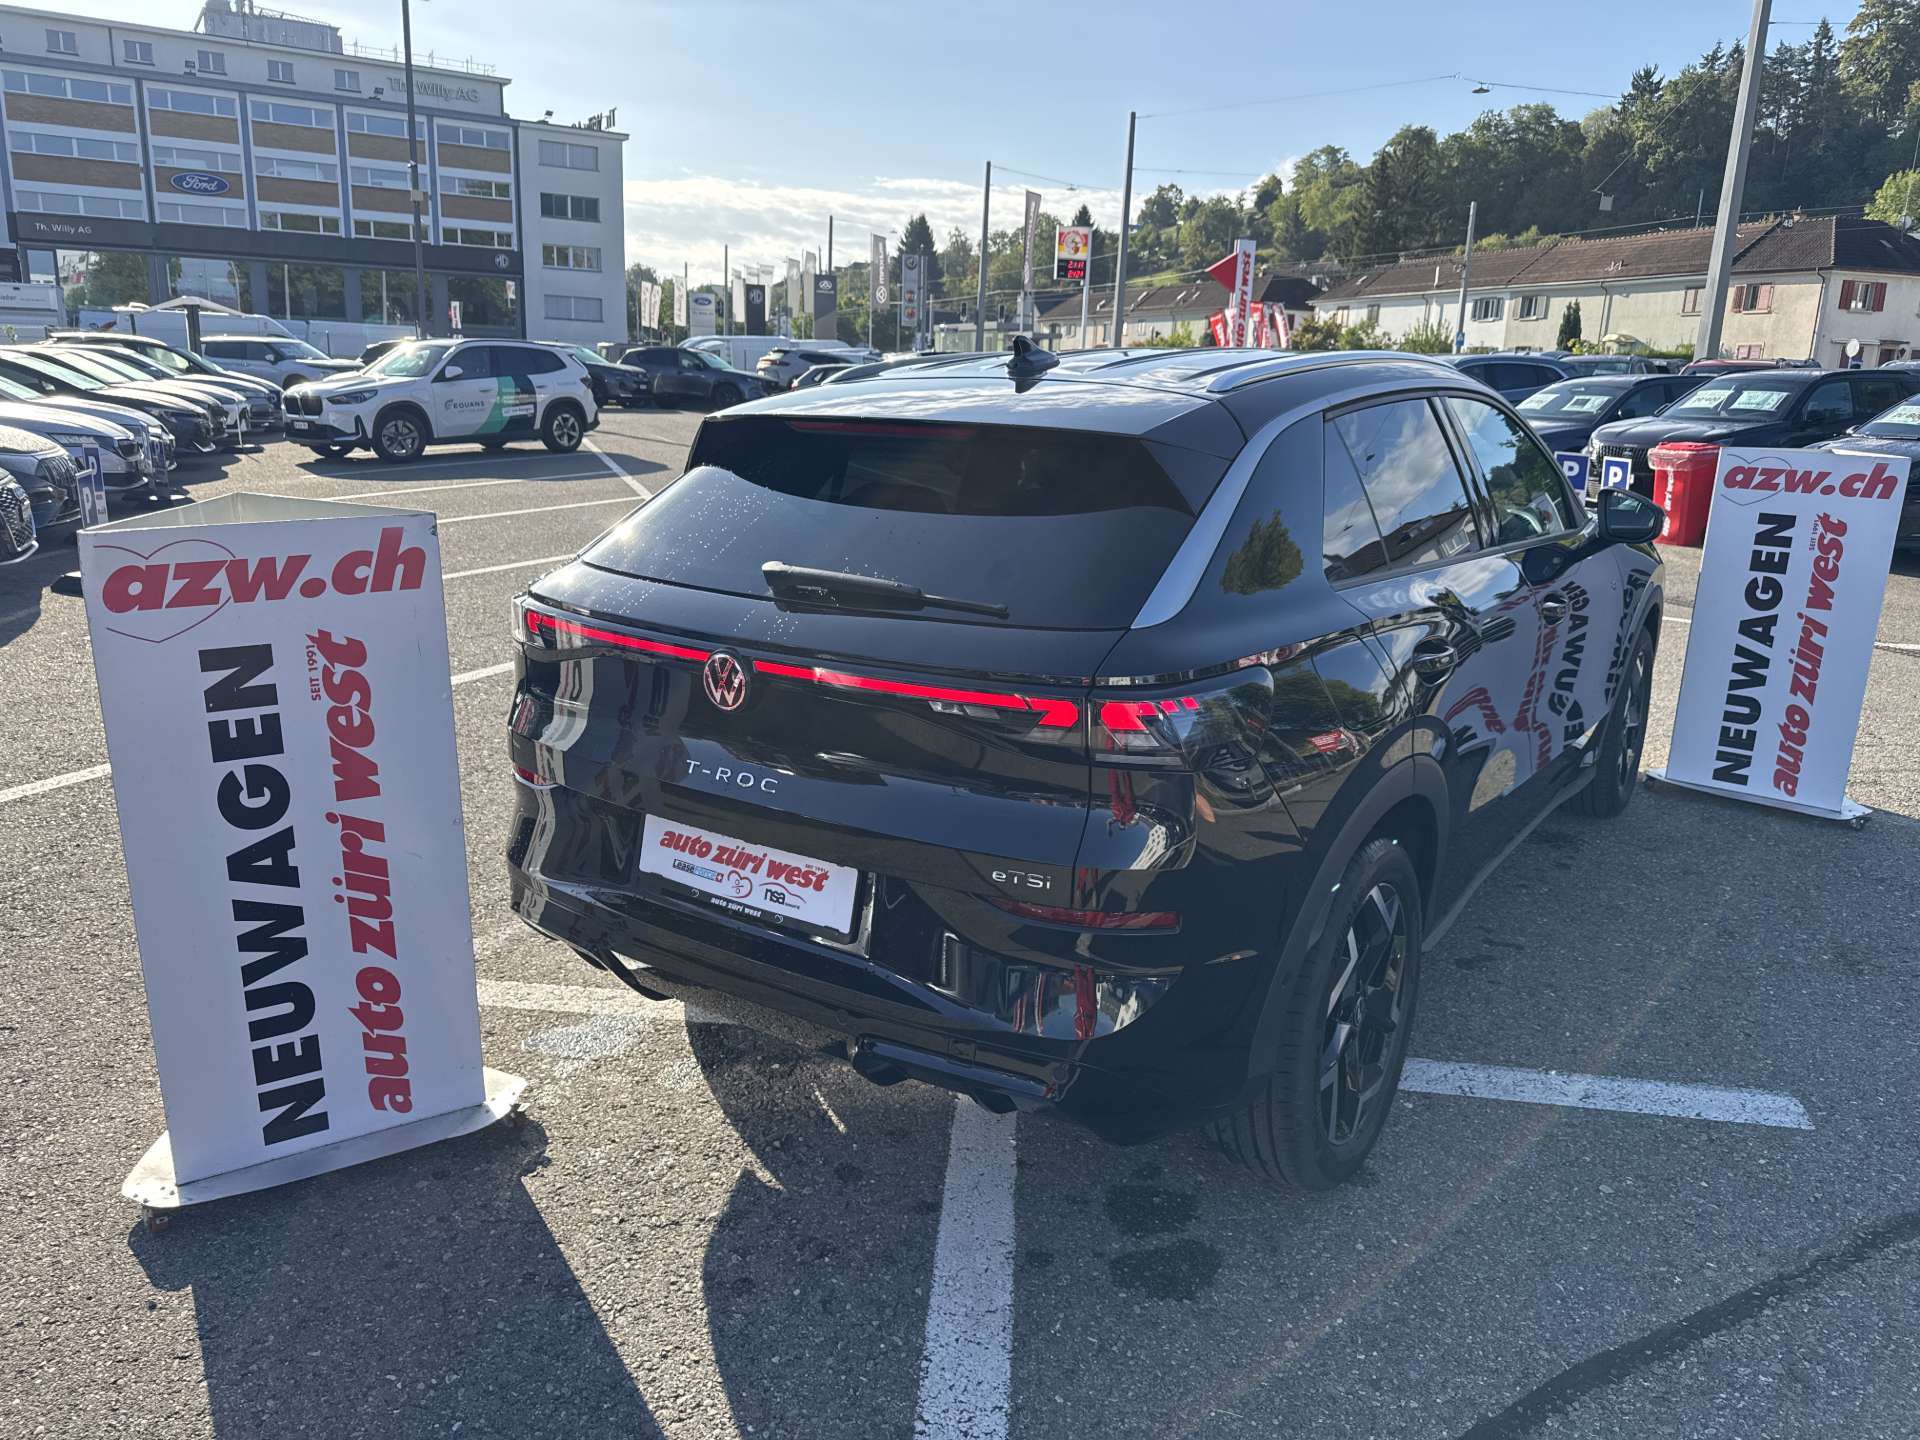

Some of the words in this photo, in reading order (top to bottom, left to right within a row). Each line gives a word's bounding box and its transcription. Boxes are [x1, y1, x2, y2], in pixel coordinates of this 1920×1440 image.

[386, 76, 409, 92] Th
[416, 79, 450, 101] Willy
[456, 85, 480, 103] AG
[179, 174, 220, 192] Ford
[51, 223, 75, 234] Willy
[78, 226, 92, 234] AG
[1608, 466, 1623, 487] P
[1723, 462, 1899, 500] azw.ch
[1806, 512, 1848, 612] west
[1808, 534, 1817, 552] SEIT
[102, 527, 426, 614] azw.ch
[307, 643, 319, 674] 1991
[1711, 512, 1797, 787] NEUWAGEN
[1788, 611, 1830, 706] züri
[311, 676, 322, 701] SEIT
[305, 628, 381, 802] west
[1773, 703, 1811, 798] auto
[686, 759, 779, 793] T-ROC
[659, 829, 713, 858] auto
[710, 844, 767, 874] züri
[765, 859, 830, 892] west
[992, 869, 1052, 889] eTSi
[198, 643, 330, 1147] NEUWAGEN
[324, 811, 398, 961] züri
[764, 887, 786, 905] nsa
[347, 966, 414, 1115] auto
